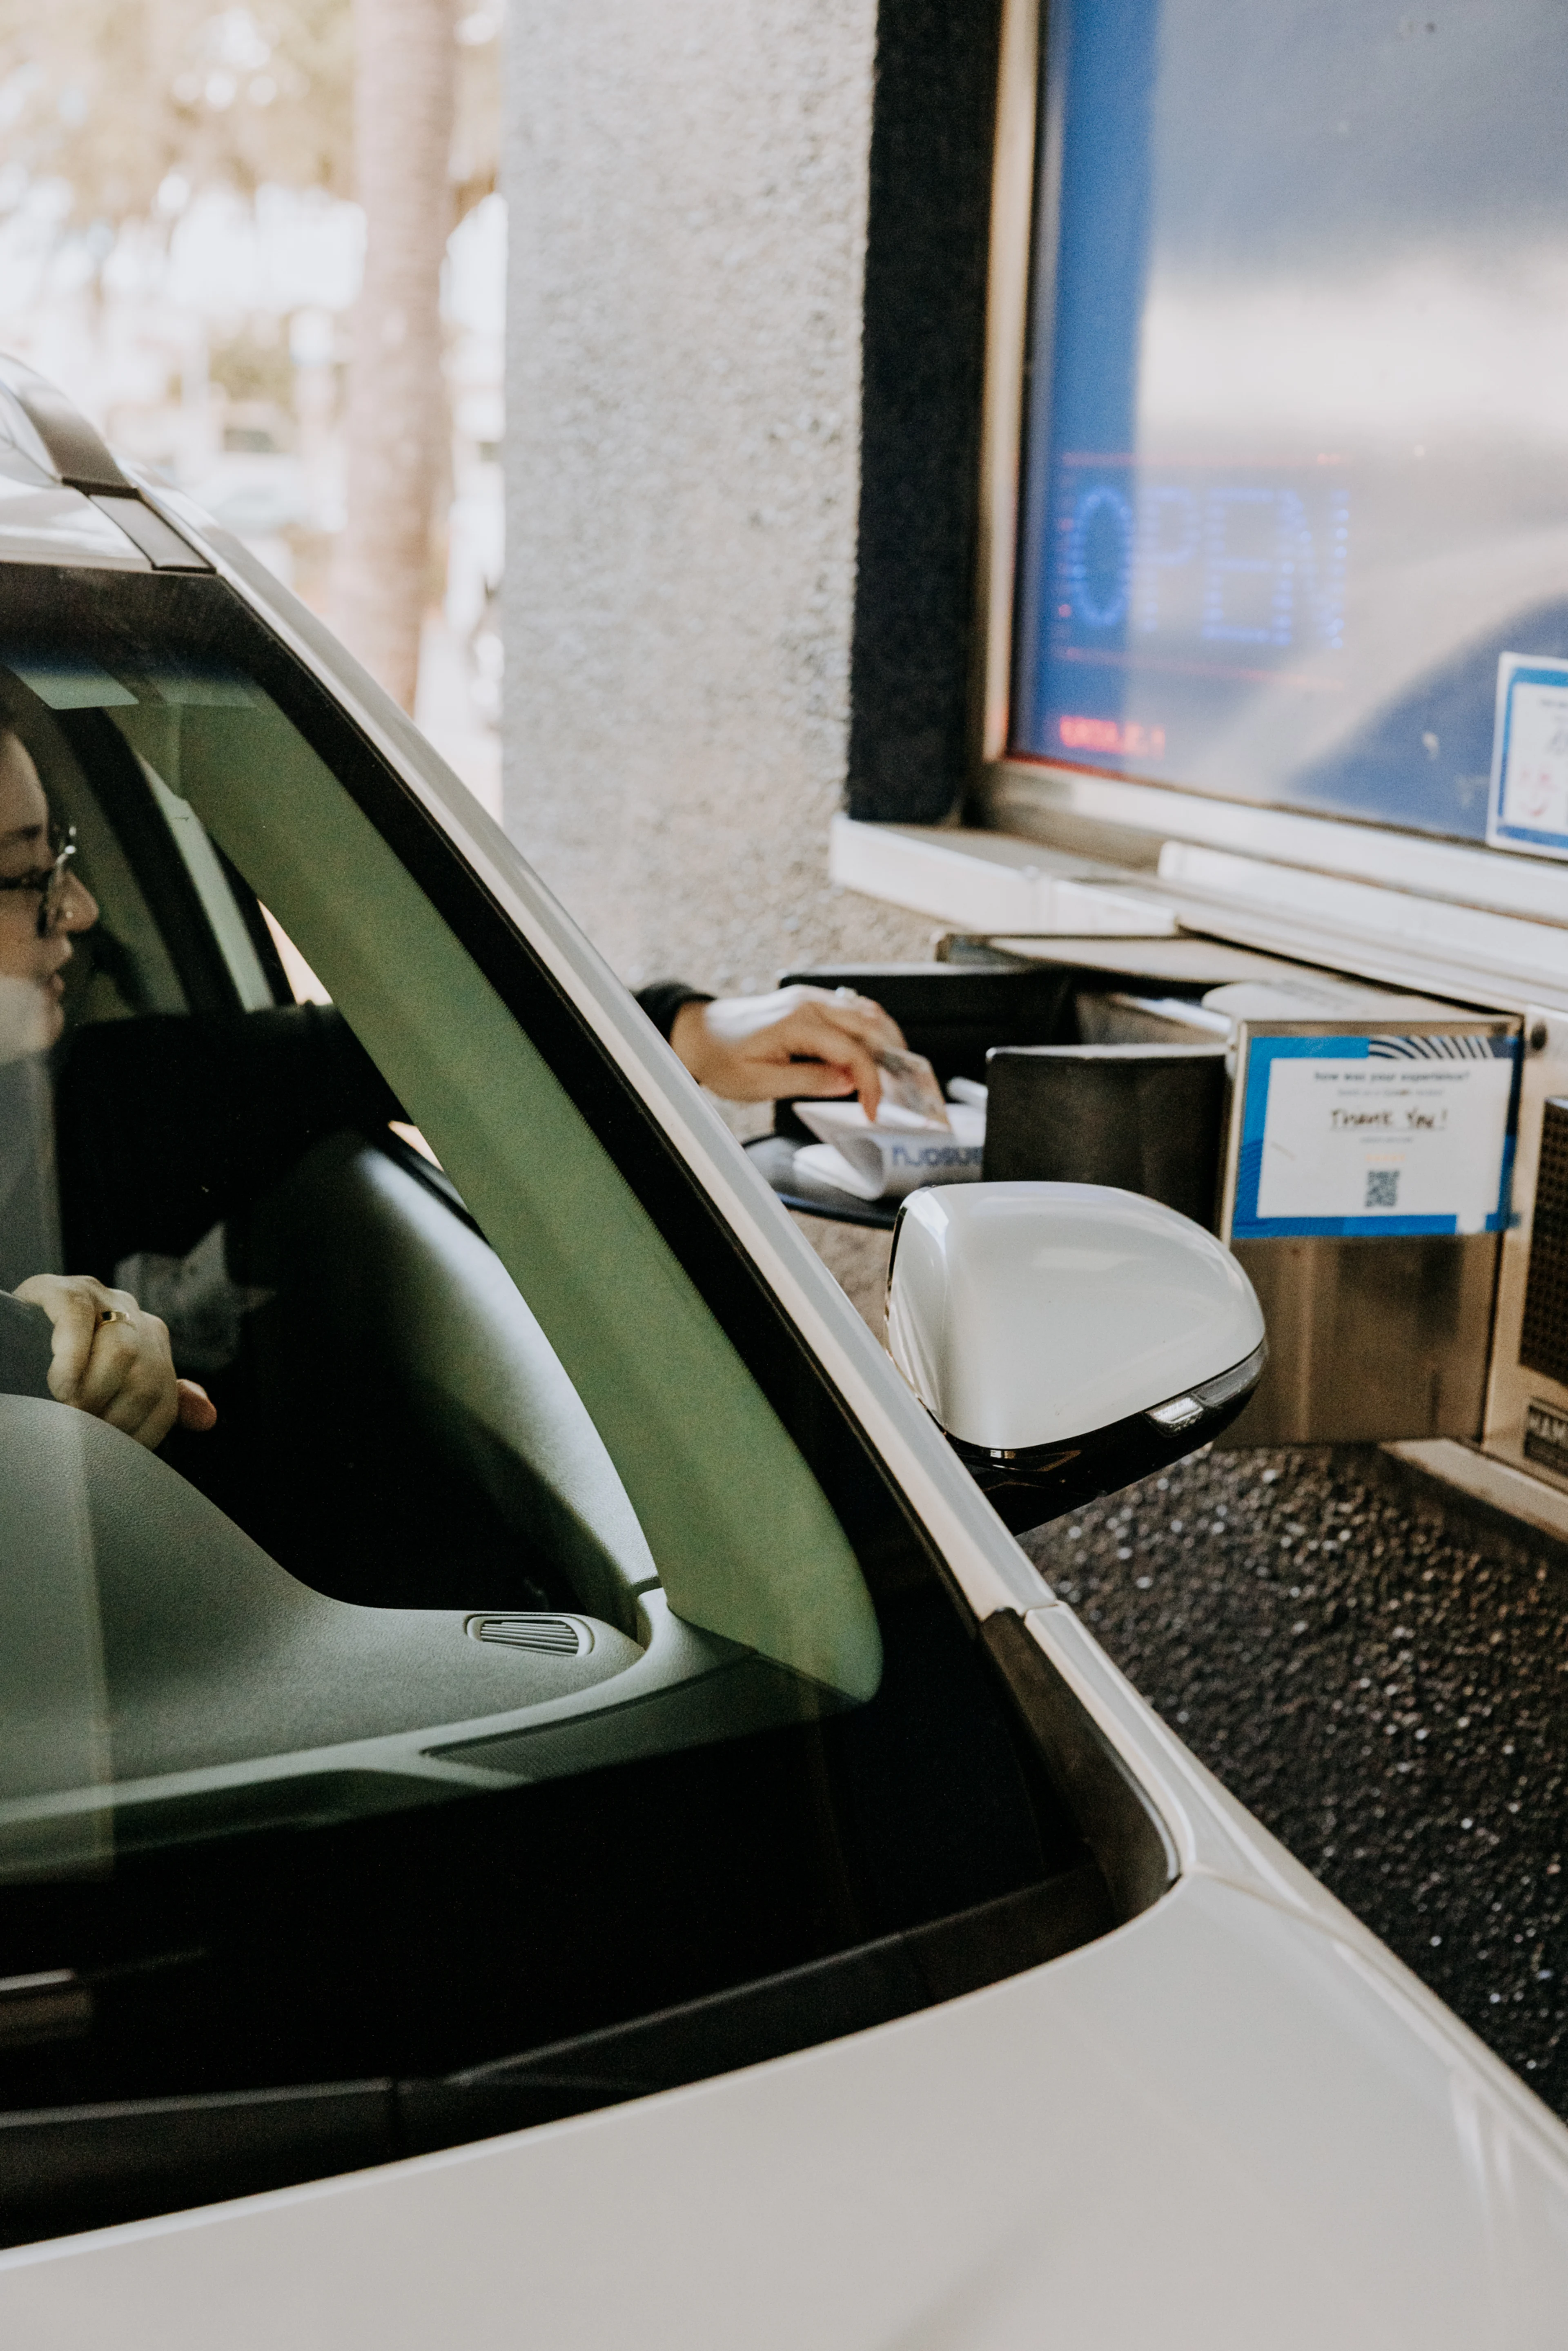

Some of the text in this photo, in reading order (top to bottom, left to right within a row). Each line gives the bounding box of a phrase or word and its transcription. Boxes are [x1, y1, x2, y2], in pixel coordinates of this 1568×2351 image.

[1071, 485, 1350, 648] OPEN
[1343, 1072, 1366, 1082] was
[1370, 1072, 1396, 1084] your
[1400, 1070, 1471, 1083] experience?
